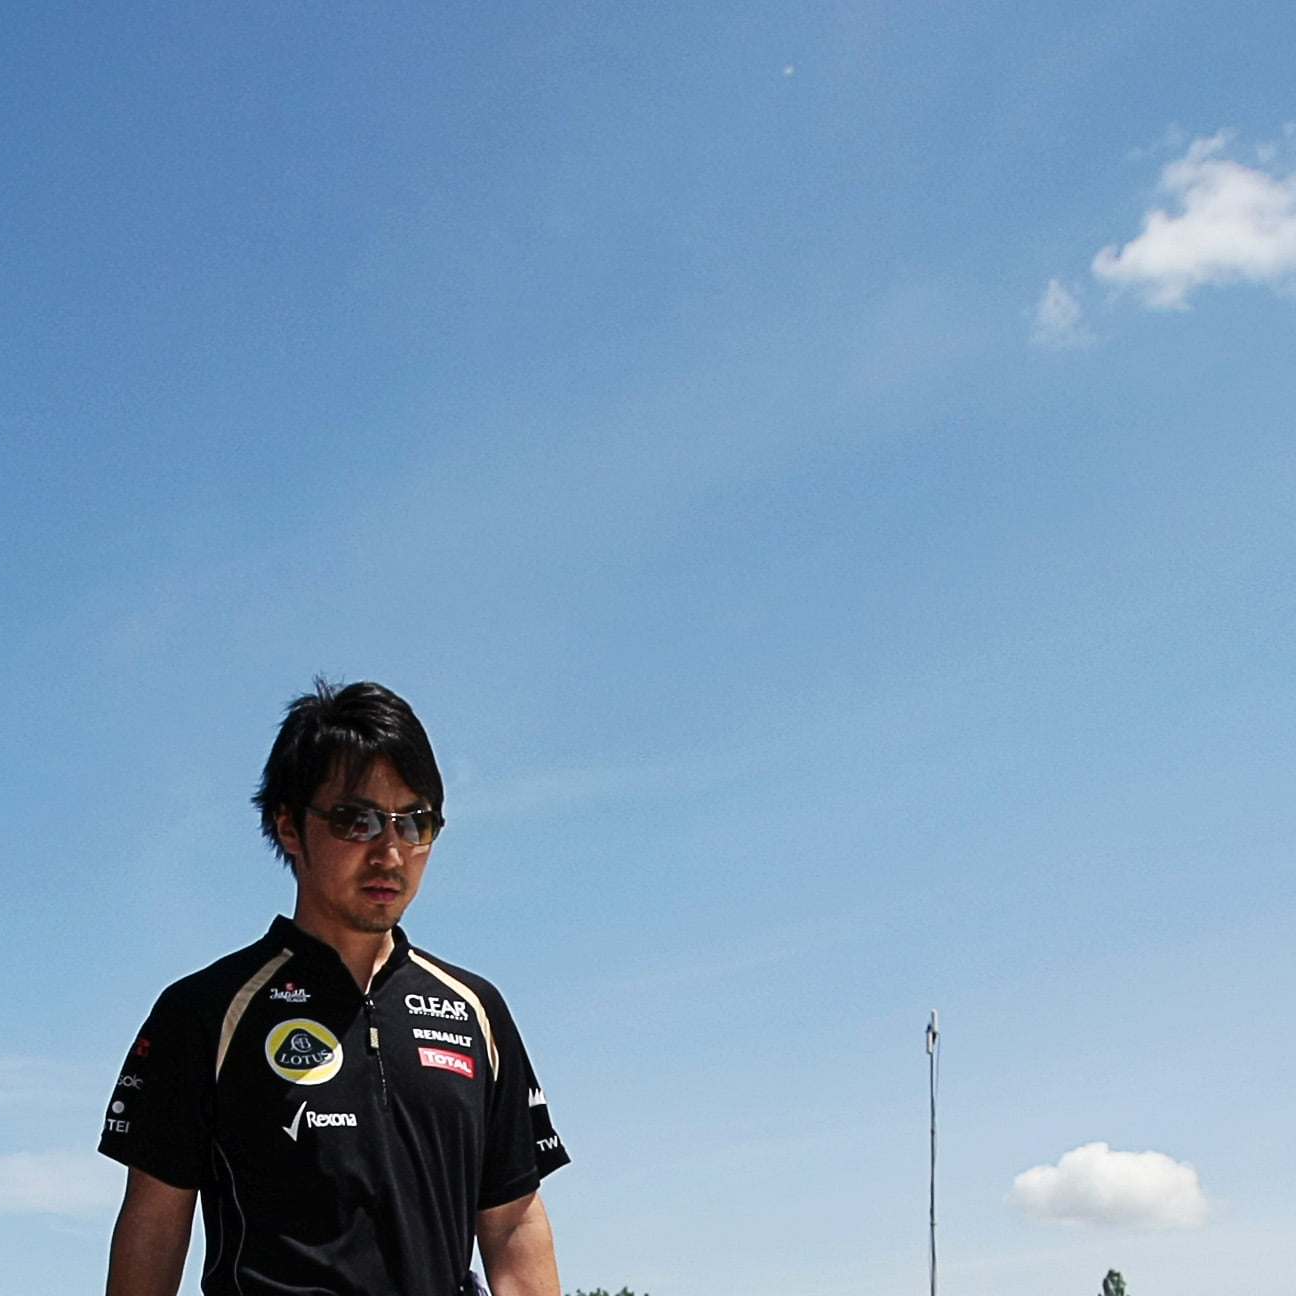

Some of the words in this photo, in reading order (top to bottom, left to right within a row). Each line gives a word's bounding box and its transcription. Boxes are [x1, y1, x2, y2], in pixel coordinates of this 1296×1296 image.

[404, 994, 468, 1018] CLEAR
[412, 1028, 472, 1048] RENAULT
[280, 1049, 334, 1066] LOTUS
[423, 1050, 472, 1074] TOTAL
[306, 1110, 357, 1129] Rexona
